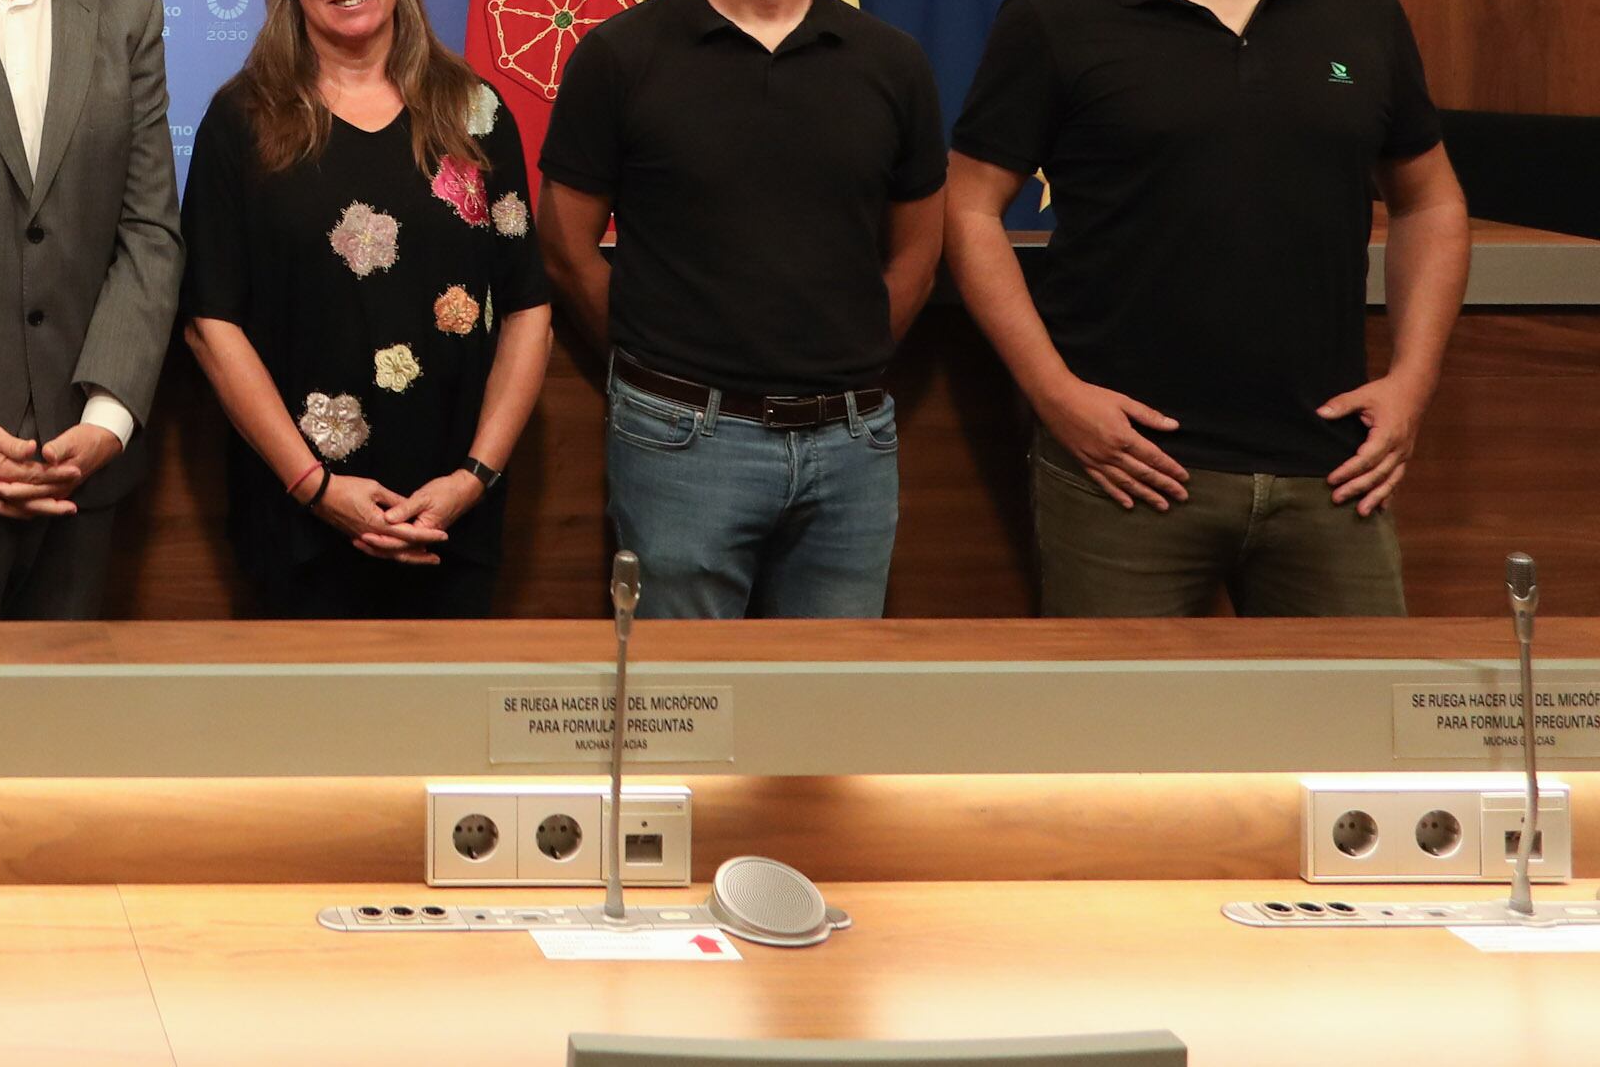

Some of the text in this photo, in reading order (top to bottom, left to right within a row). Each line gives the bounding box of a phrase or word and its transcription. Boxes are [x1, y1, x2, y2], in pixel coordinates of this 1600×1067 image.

[206, 30, 248, 41] 2030
[504, 693, 718, 712] SE RUEGA HACER US DEL MICRÓFONO
[1412, 693, 1425, 708] SE
[1428, 693, 1466, 708] RUEGA
[1469, 693, 1506, 708] HACER
[1509, 693, 1524, 707] US
[1535, 693, 1555, 707] DEL
[529, 718, 694, 733] PARA FORMULA PREGUNTAS
[1437, 715, 1600, 730] PARA FORMULA PREGUNTAS
[575, 739, 610, 750] MUCHAS
[1483, 736, 1518, 747] MUCHAS
